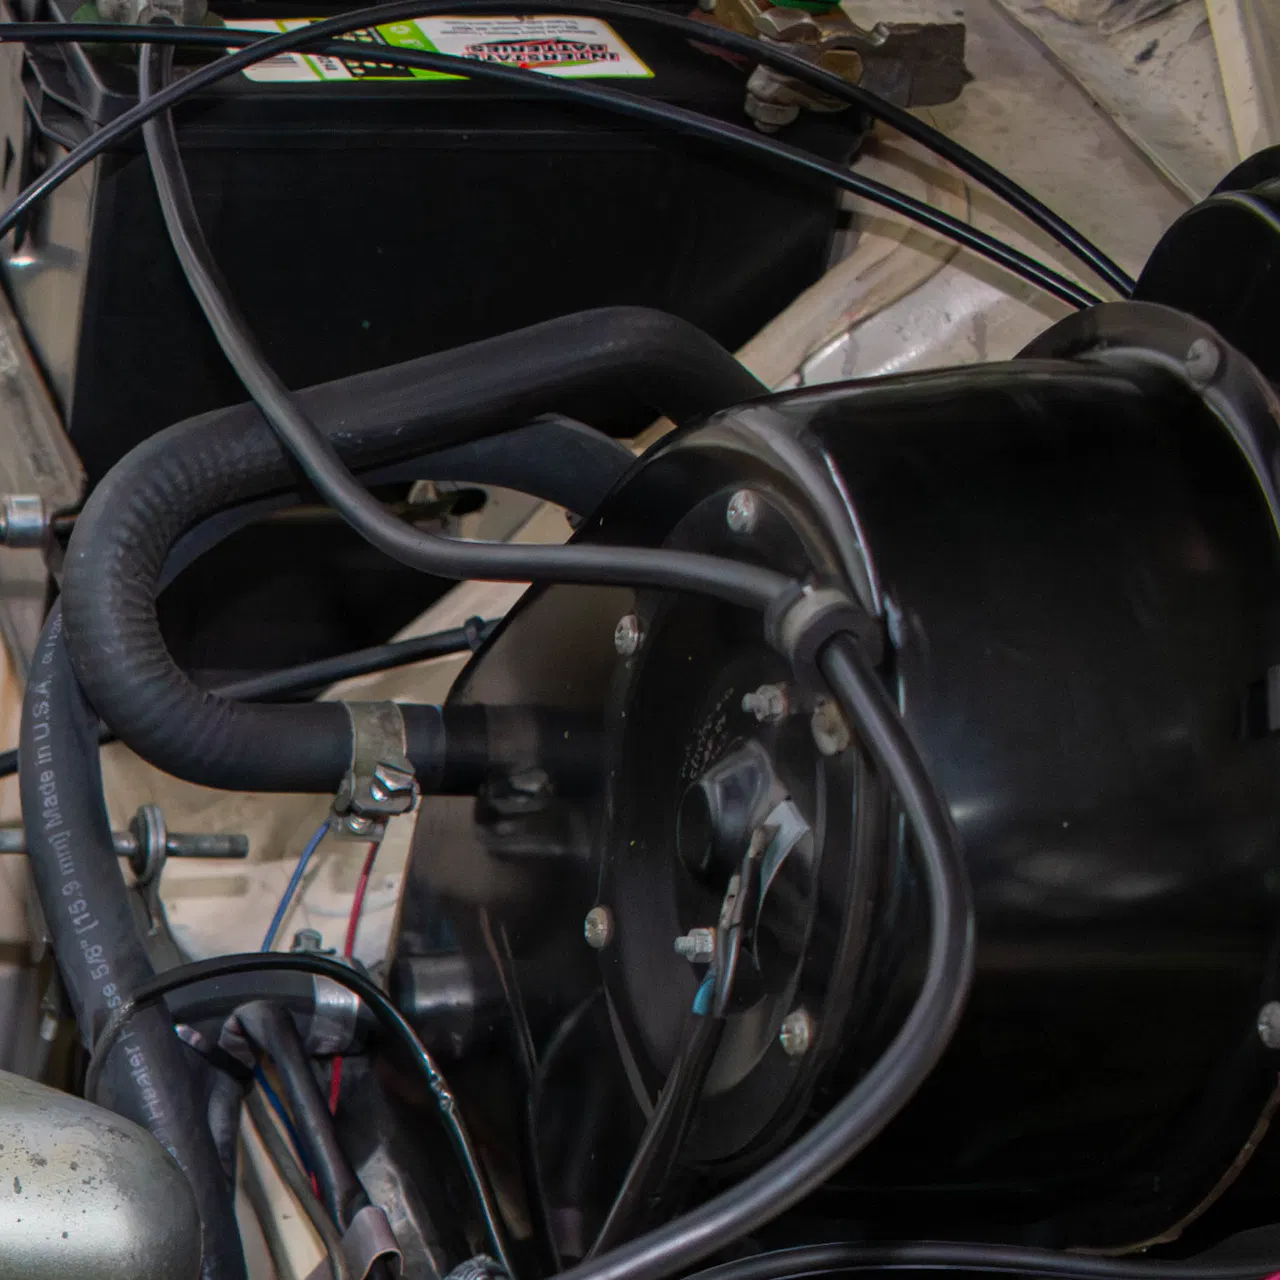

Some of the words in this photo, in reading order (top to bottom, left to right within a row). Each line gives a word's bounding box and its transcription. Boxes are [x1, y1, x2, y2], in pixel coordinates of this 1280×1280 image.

[467, 43, 608, 53] BATTERIES
[34, 744, 53, 767] in
[38, 768, 64, 830] Made
